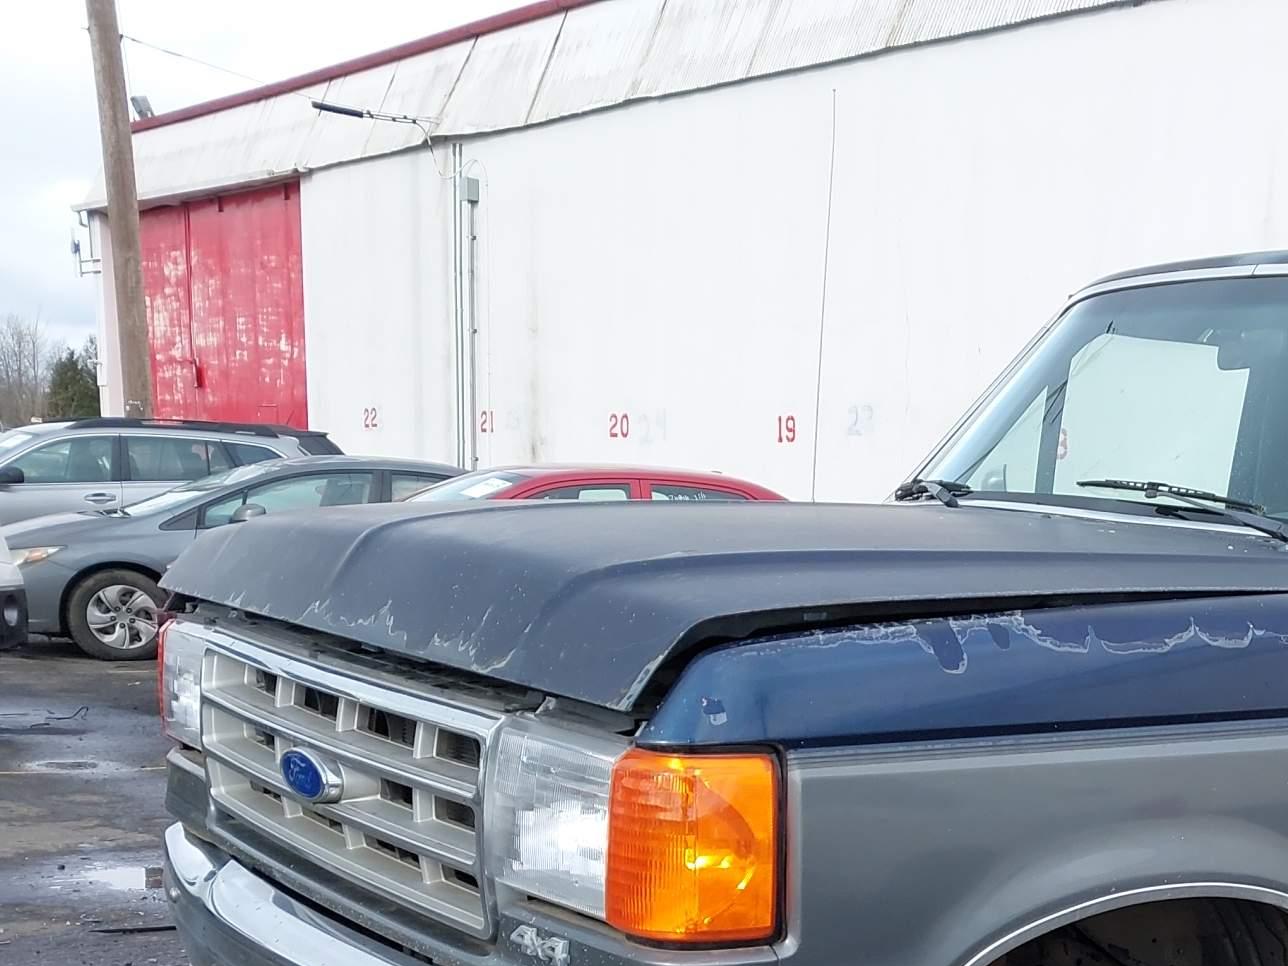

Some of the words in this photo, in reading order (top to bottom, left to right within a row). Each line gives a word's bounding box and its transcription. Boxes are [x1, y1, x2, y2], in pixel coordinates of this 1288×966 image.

[363, 407, 378, 429] 22
[480, 410, 495, 433] 21
[609, 413, 630, 439] 20
[777, 415, 796, 443] 19
